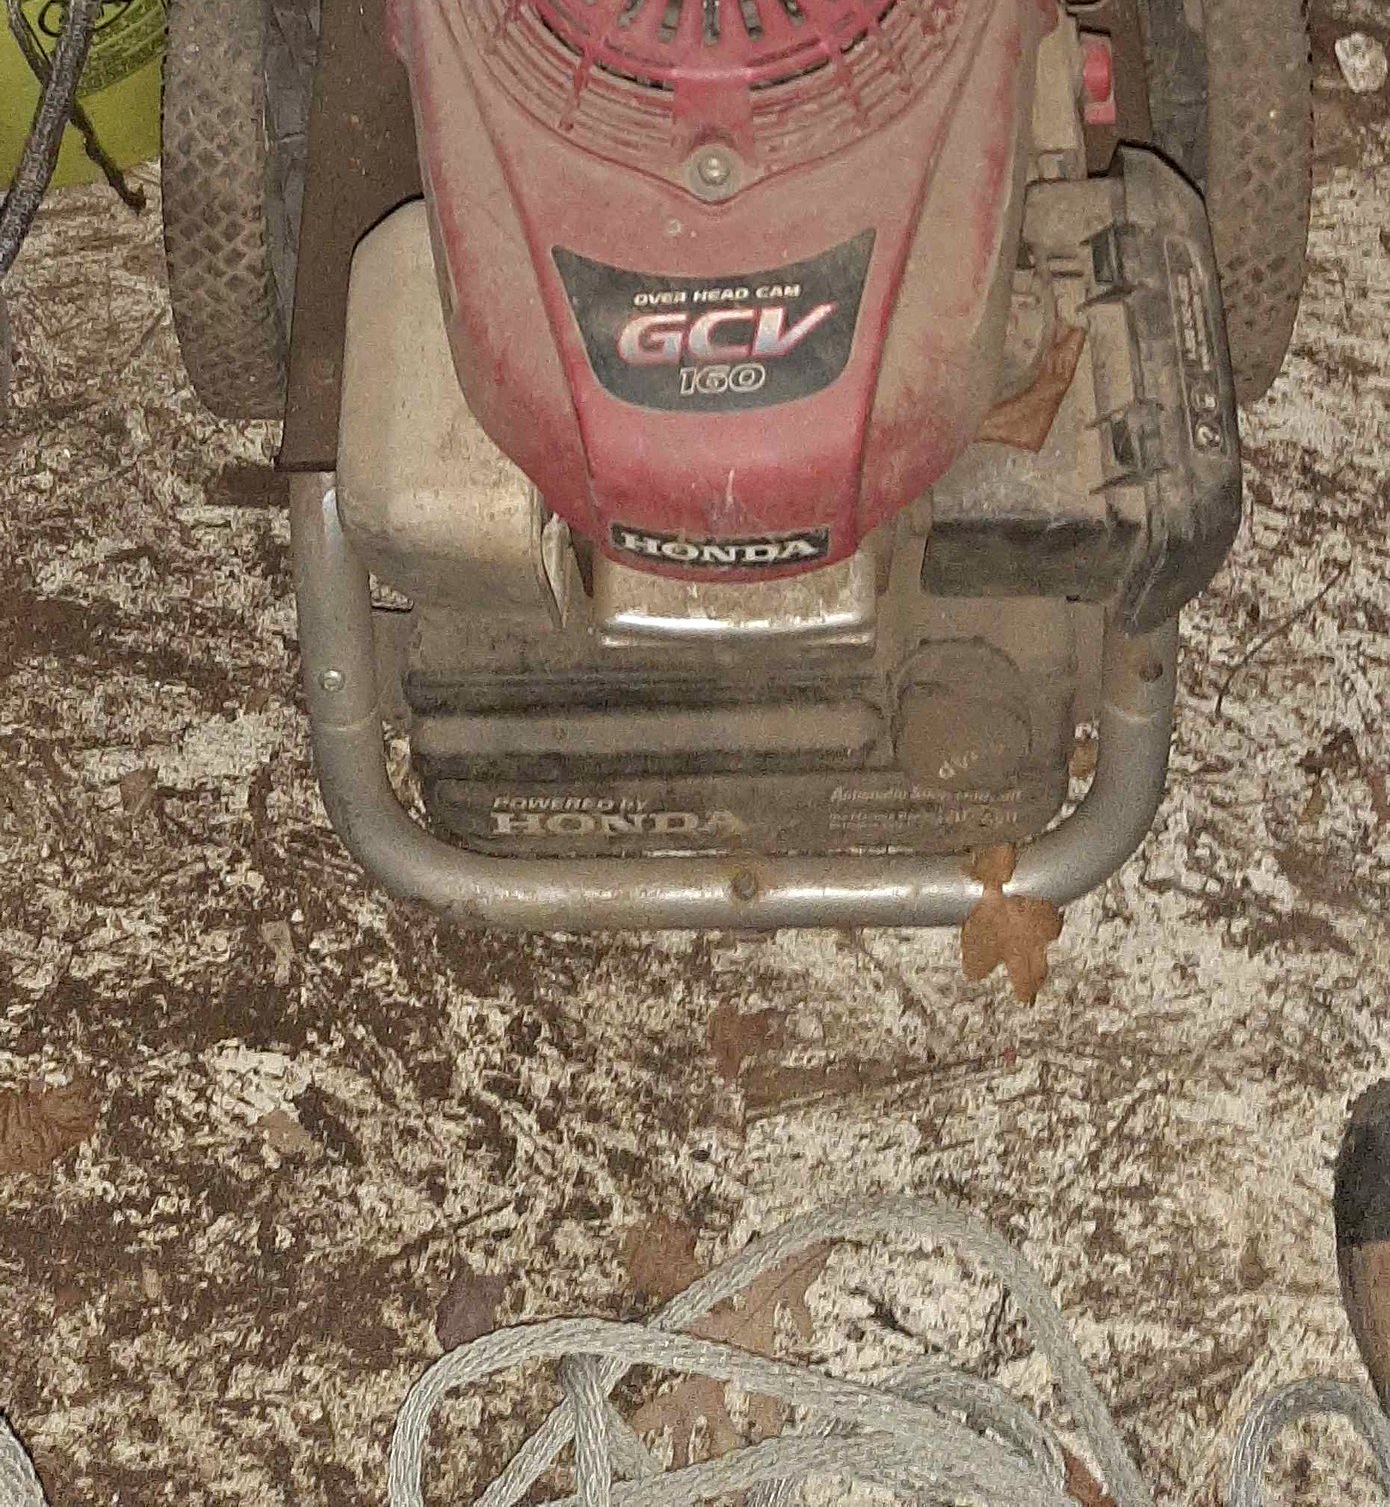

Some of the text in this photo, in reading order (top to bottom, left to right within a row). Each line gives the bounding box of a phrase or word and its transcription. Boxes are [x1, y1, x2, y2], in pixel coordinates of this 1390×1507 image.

[633, 284, 800, 306] OVER HEAD CAM
[616, 300, 838, 366] GCV
[678, 362, 766, 395] 160
[620, 531, 820, 564] HONDA
[490, 810, 747, 836] HONDA
